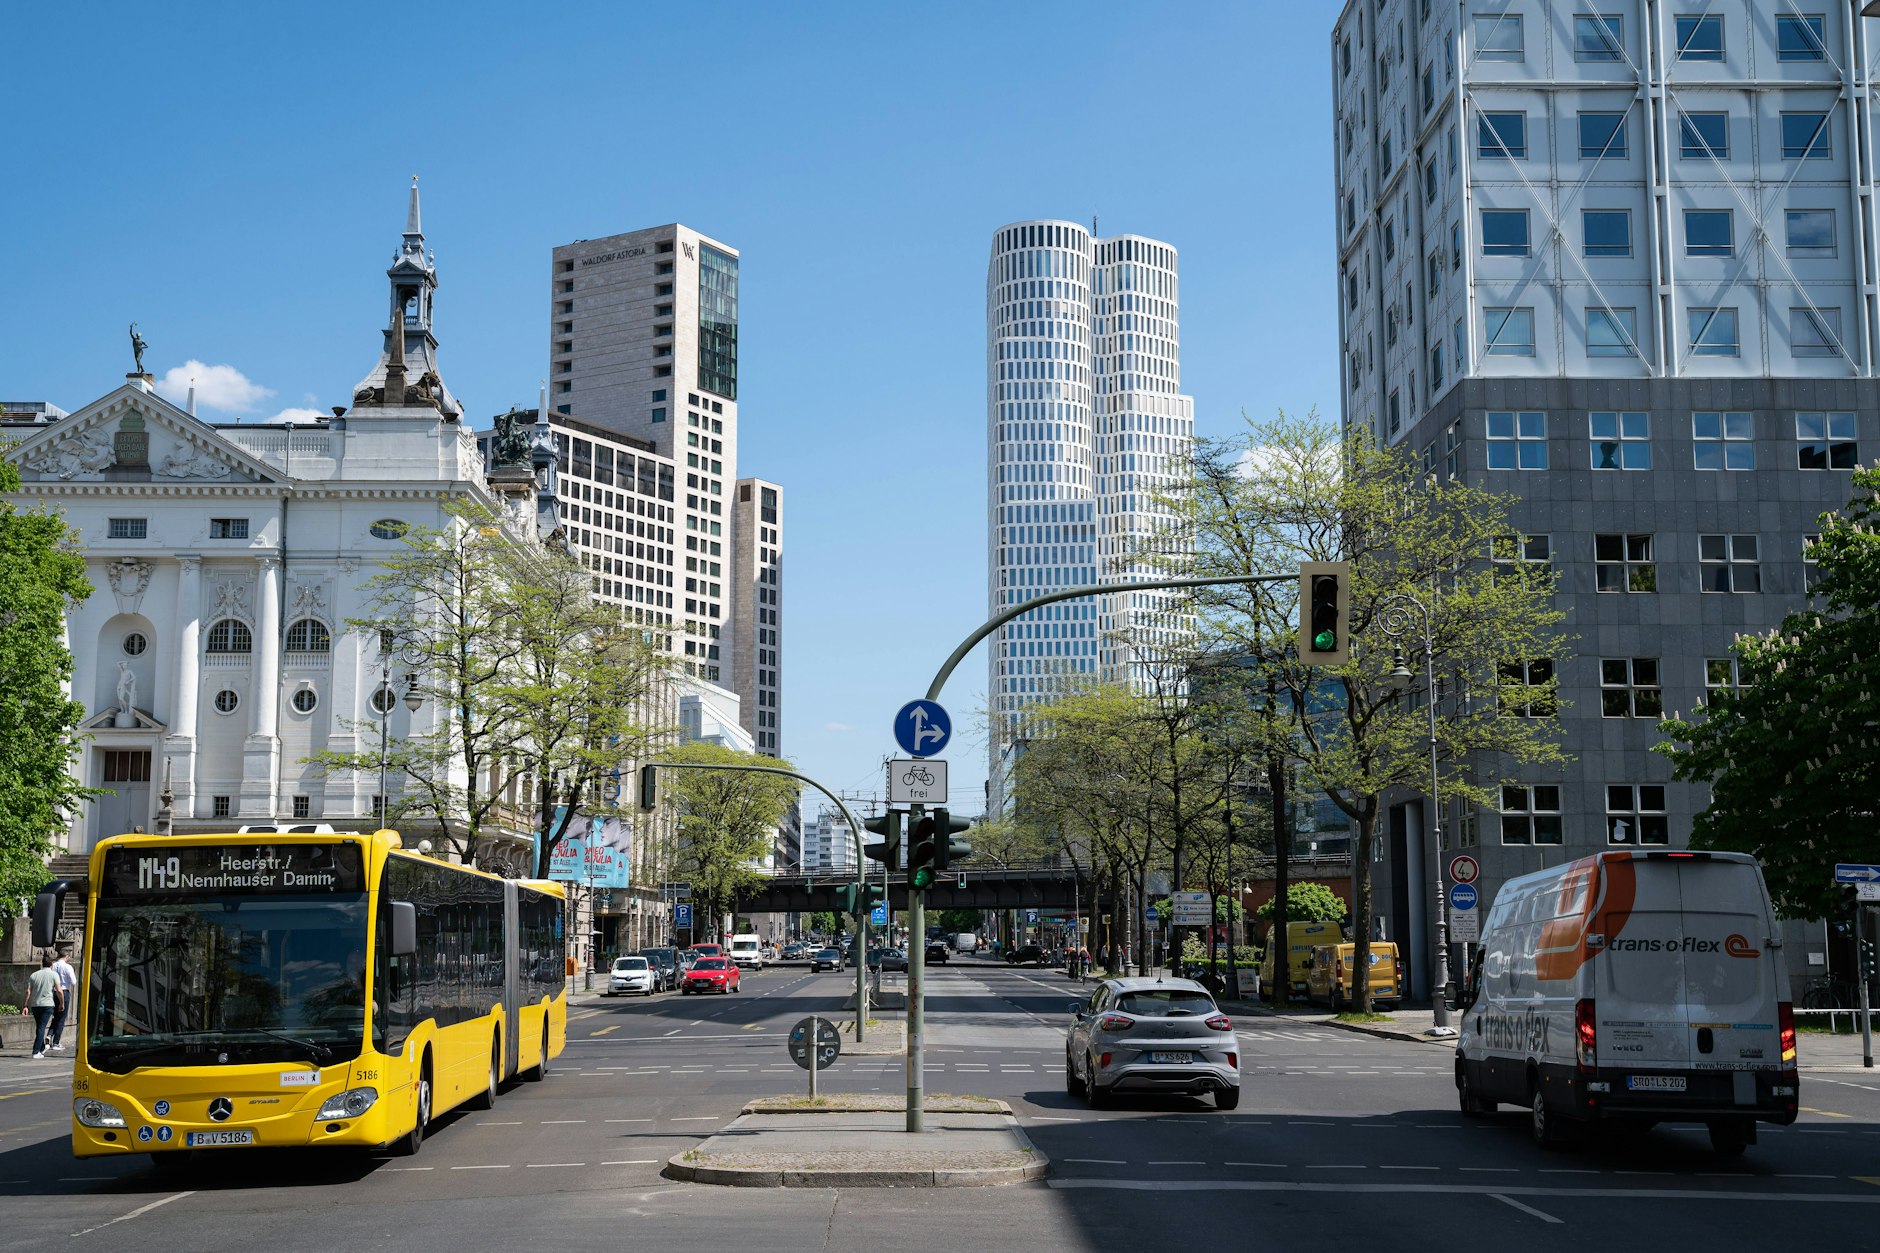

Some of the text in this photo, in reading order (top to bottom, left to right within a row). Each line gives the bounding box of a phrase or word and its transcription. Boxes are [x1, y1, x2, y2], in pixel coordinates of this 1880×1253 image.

[581, 247, 647, 266] WALDORF ASTORIA
[909, 788, 928, 798] frei
[220, 855, 292, 871] Heerstr./
[139, 857, 180, 889] M49
[181, 871, 332, 889] Nennhauser Damm
[1695, 1062, 1778, 1071] www.trans-o-flex.com
[356, 1070, 378, 1081] 5186
[1633, 1077, 1686, 1088] SRO LS 202
[197, 1131, 247, 1144] B V 5186
